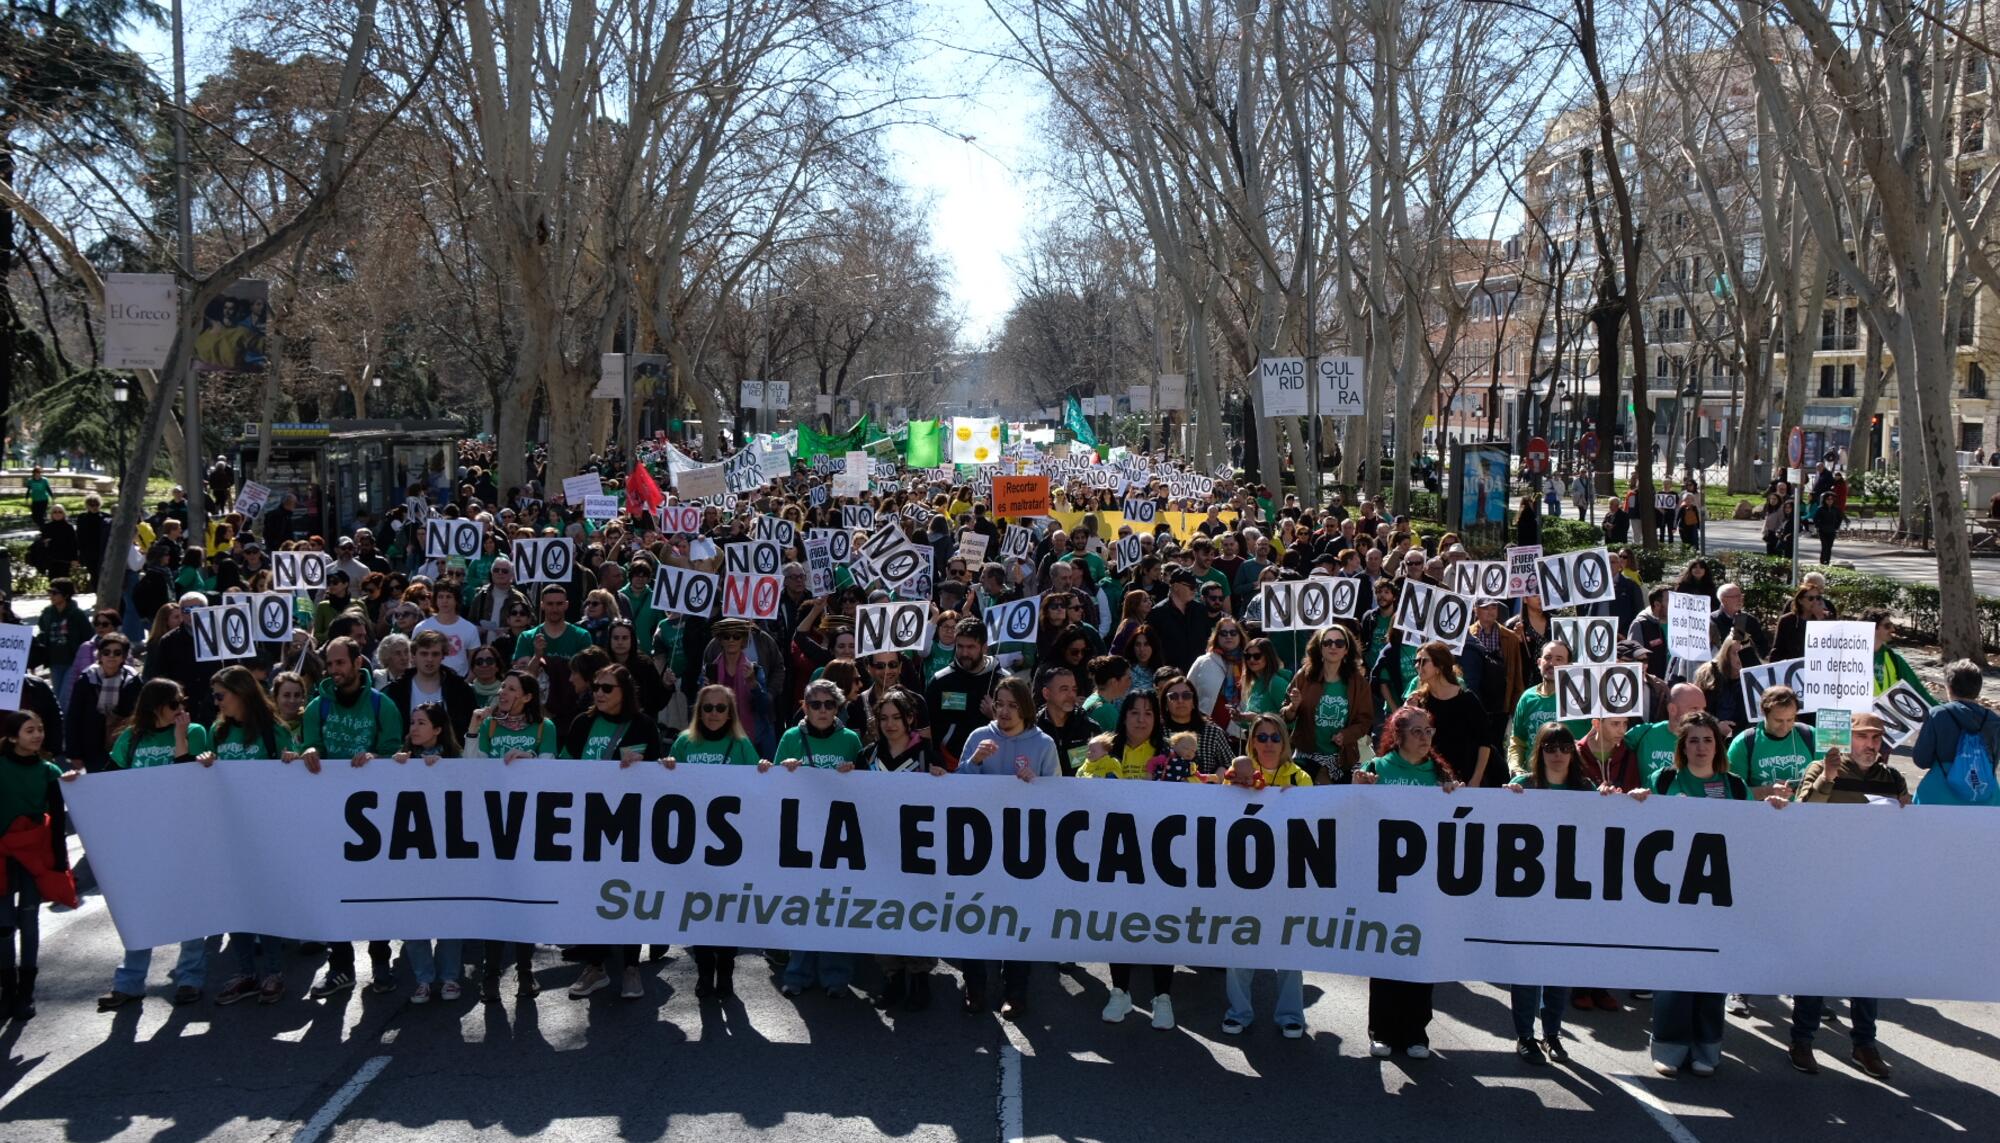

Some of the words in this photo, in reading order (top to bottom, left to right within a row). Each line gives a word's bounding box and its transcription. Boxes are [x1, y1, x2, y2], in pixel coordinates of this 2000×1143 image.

[111, 303, 124, 319] El
[126, 304, 171, 321] Greco
[1263, 361, 1304, 376] MAD
[1320, 361, 1354, 375] CUL
[1279, 376, 1304, 390] RID
[1326, 376, 1349, 390] TU
[1338, 391, 1361, 404] RA
[876, 464, 896, 477] NO
[1070, 454, 1090, 469] NO
[1129, 456, 1147, 470] NO
[1155, 463, 1173, 476] NO
[1216, 465, 1233, 479] NO
[926, 468, 944, 481] NO
[1087, 470, 1106, 486] NO
[1192, 477, 1212, 493] NO
[811, 486, 826, 503] NO
[1656, 494, 1676, 507] NO
[906, 506, 928, 523] NO
[998, 504, 1006, 512] es
[1010, 500, 1045, 512] maltratar!
[1124, 500, 1154, 523] NO
[663, 507, 699, 532] NO
[844, 508, 873, 528] NO
[428, 521, 480, 556] NO
[757, 516, 793, 545] NO
[1001, 525, 1029, 555] NO
[515, 539, 570, 583] NO
[727, 542, 780, 574] NO
[862, 524, 920, 581] NO
[1118, 534, 1141, 571] NO
[275, 554, 325, 587] NO
[1457, 563, 1507, 596] NO
[1537, 551, 1610, 606] NO
[653, 566, 714, 613] NO
[723, 575, 780, 617] NO
[1264, 582, 1331, 628] NO
[1398, 579, 1468, 640] NO
[859, 603, 924, 655] NO
[985, 599, 1037, 643] NO
[1672, 617, 1679, 628] es
[1680, 617, 1688, 629] de
[193, 607, 250, 658] NO
[1553, 619, 1615, 662] NO
[1807, 634, 1819, 649] La
[1820, 634, 1870, 652] educación,
[1810, 660, 1822, 671] un
[1827, 659, 1866, 675] derecho,
[1559, 666, 1639, 717] NO
[1806, 682, 1821, 694] no
[1823, 681, 1870, 699] negocio!
[1874, 687, 1930, 745] NO
[1758, 755, 1806, 768] UNIVERSIDAD
[343, 790, 743, 867] SALVEMOS
[779, 798, 866, 871] LA
[900, 803, 1337, 890] EDUCACIÓN
[1378, 806, 1733, 907] PÚBLICA
[596, 879, 664, 921] Su
[680, 882, 1033, 943] privatización,
[1051, 905, 1262, 947] nuestra
[1280, 906, 1422, 956] ruina
